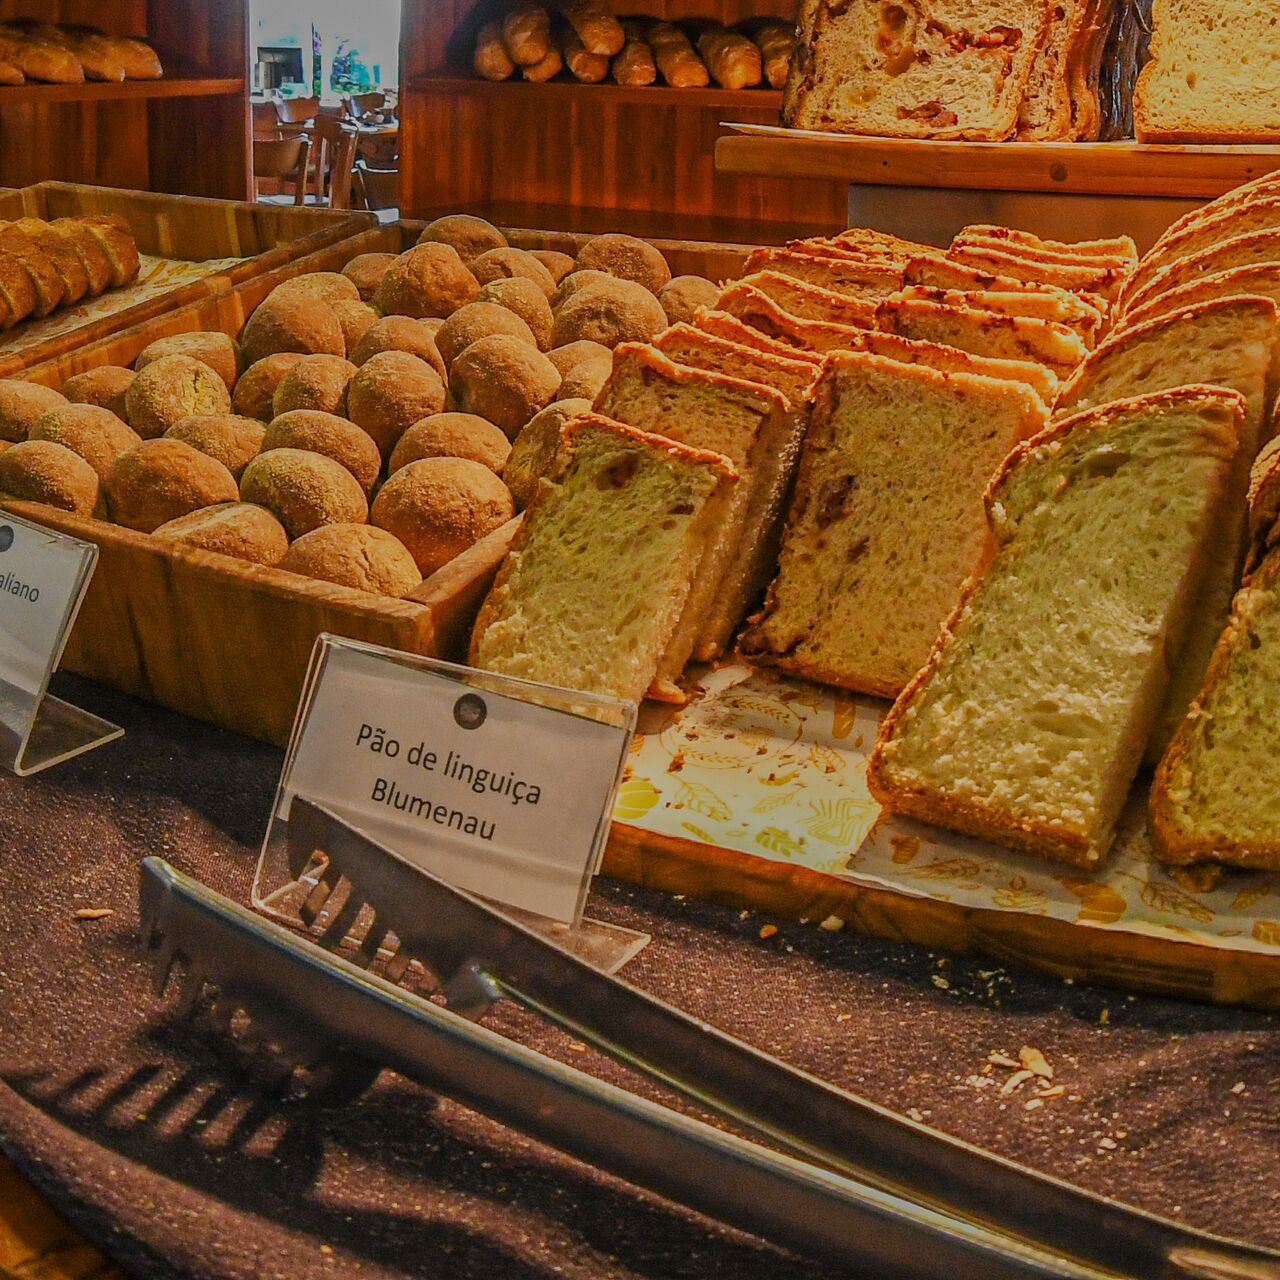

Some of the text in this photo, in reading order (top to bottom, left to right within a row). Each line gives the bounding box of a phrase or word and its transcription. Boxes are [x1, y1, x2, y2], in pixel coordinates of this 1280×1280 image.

[355, 723, 542, 806] Pão de linguiça
[370, 777, 498, 841] Blumenau
